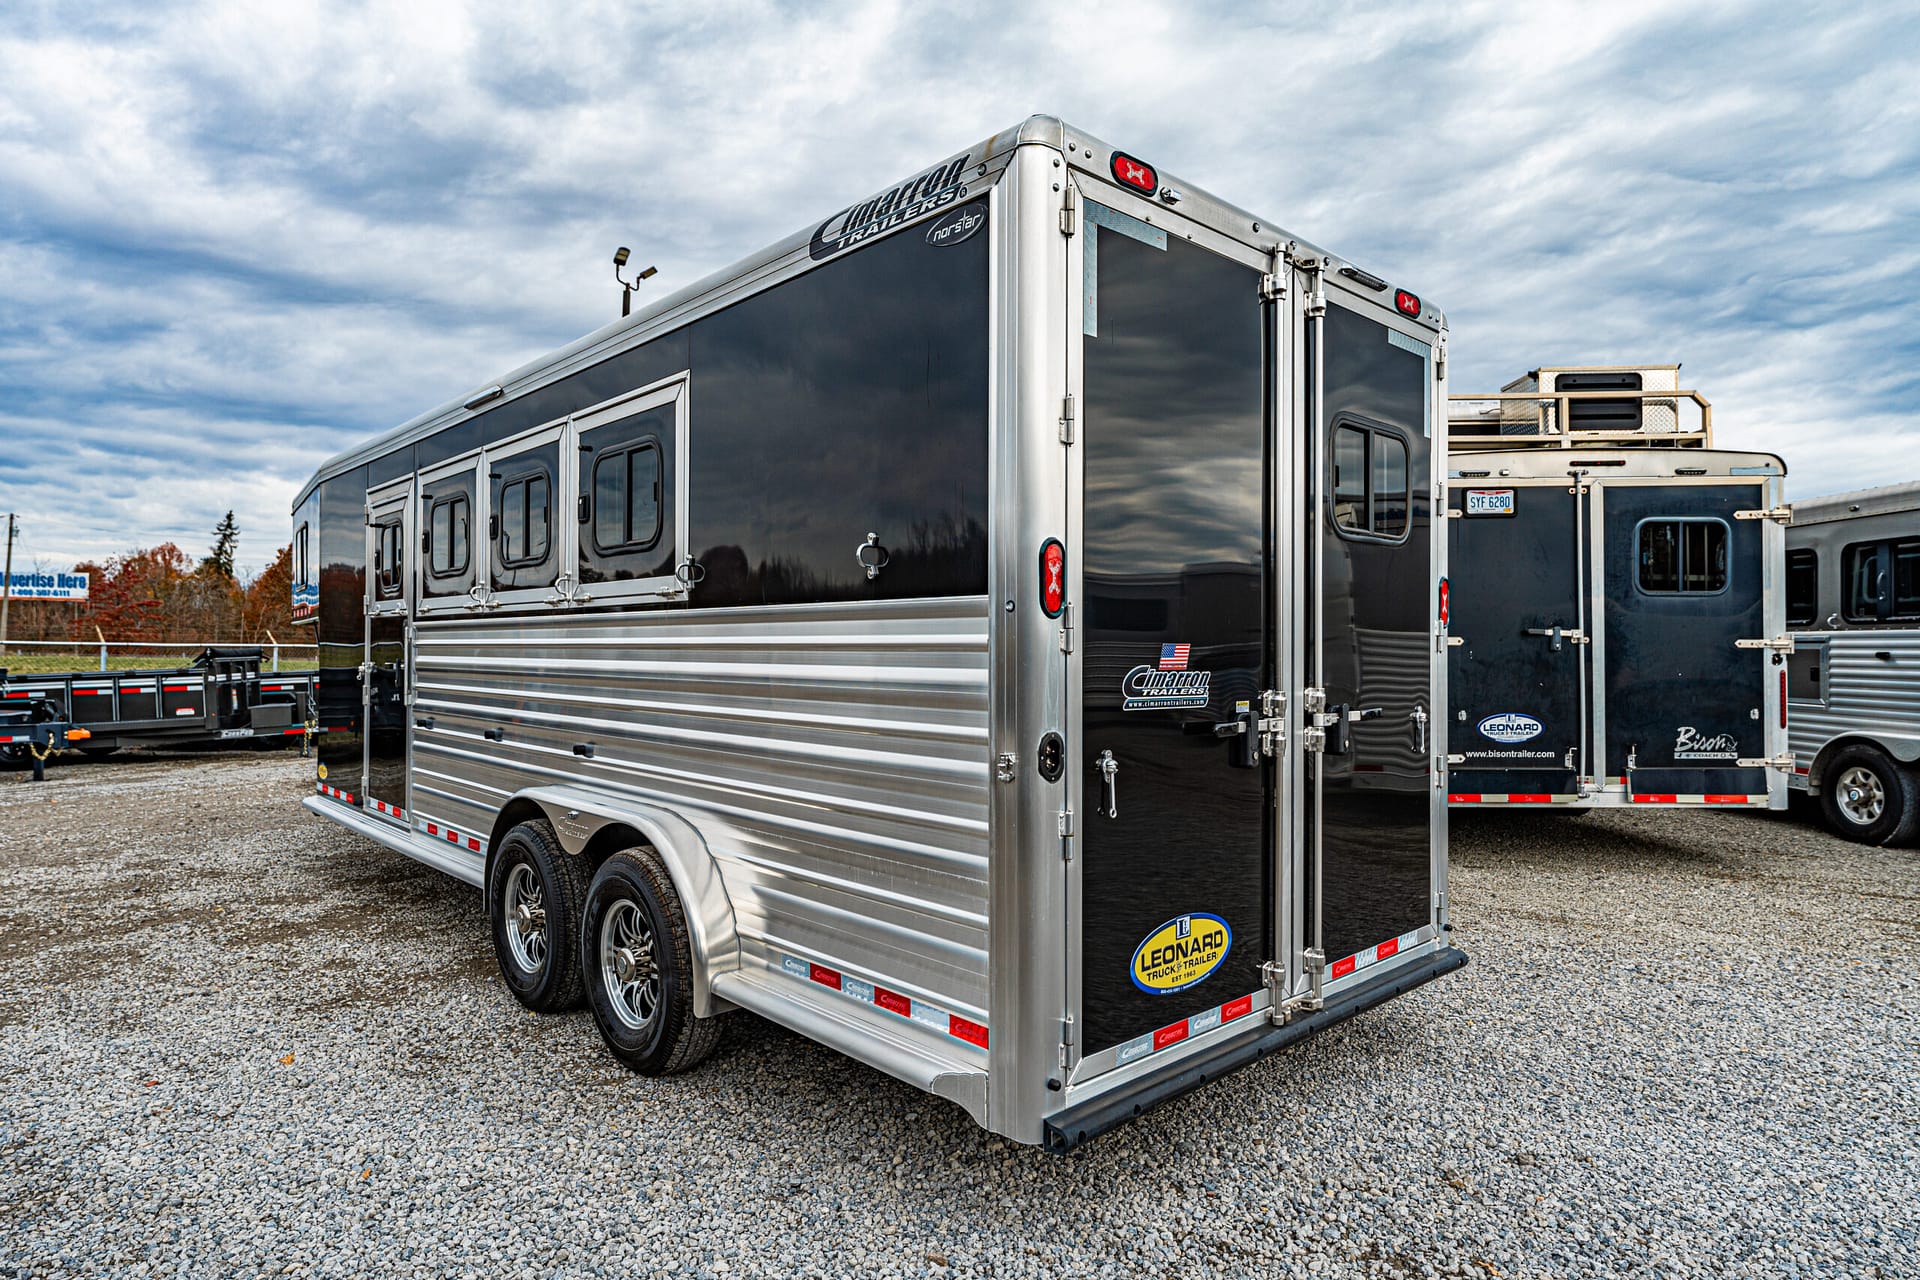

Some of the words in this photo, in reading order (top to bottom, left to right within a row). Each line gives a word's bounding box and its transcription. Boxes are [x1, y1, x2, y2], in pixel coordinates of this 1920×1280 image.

[809, 154, 971, 258] Cimarron
[837, 188, 956, 249] TRAILERS
[933, 209, 981, 242] norstar
[1470, 496, 1486, 508] SYF
[1488, 496, 1510, 508] 6280
[57, 573, 87, 589] Here
[1122, 665, 1211, 697] Cimarron
[1141, 687, 1204, 696] TRAILERS
[1128, 699, 1205, 708] www.cimarrontrailers.com
[1483, 723, 1539, 732] LEONARD
[1674, 726, 1726, 752] Bison
[1465, 749, 1555, 758] www.bisontrailer.com
[1141, 929, 1223, 972] LEONARD
[1146, 964, 1176, 982] TRUCK
[1183, 951, 1217, 970] TRAILER
[1171, 974, 1182, 983] EST
